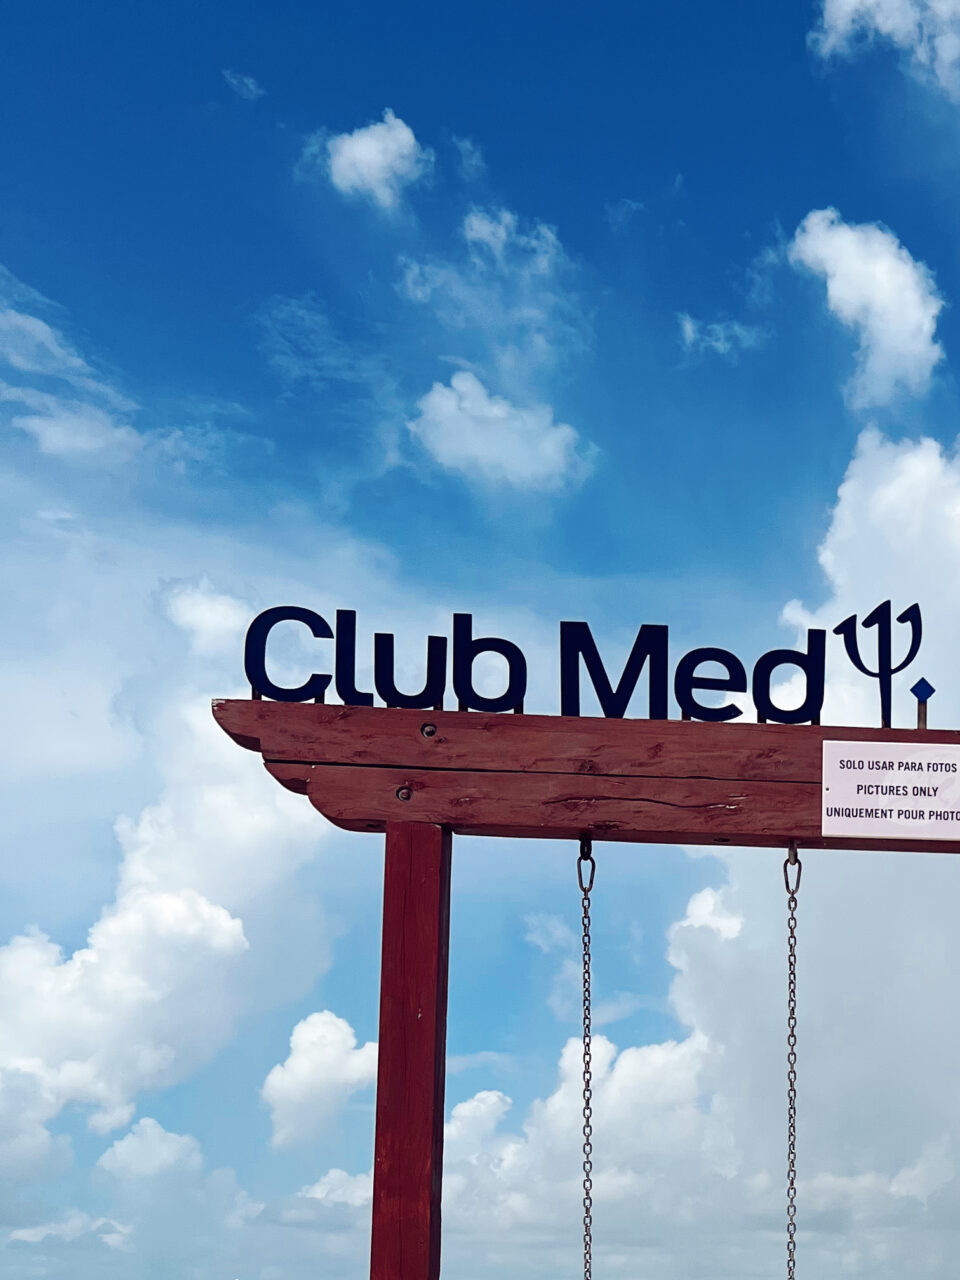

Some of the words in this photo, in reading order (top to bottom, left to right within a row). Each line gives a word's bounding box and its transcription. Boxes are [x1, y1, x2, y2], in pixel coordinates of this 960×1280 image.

[243, 605, 528, 712] Club
[559, 621, 827, 724] Med
[839, 759, 865, 770] SOLO
[868, 760, 895, 771] USAR
[898, 761, 924, 772] PARA
[927, 762, 958, 773] FOTOS
[856, 784, 908, 796] PICTURES
[912, 786, 939, 797] ONLY
[826, 807, 894, 820] UNIQUEMENT
[898, 809, 925, 820] POUR
